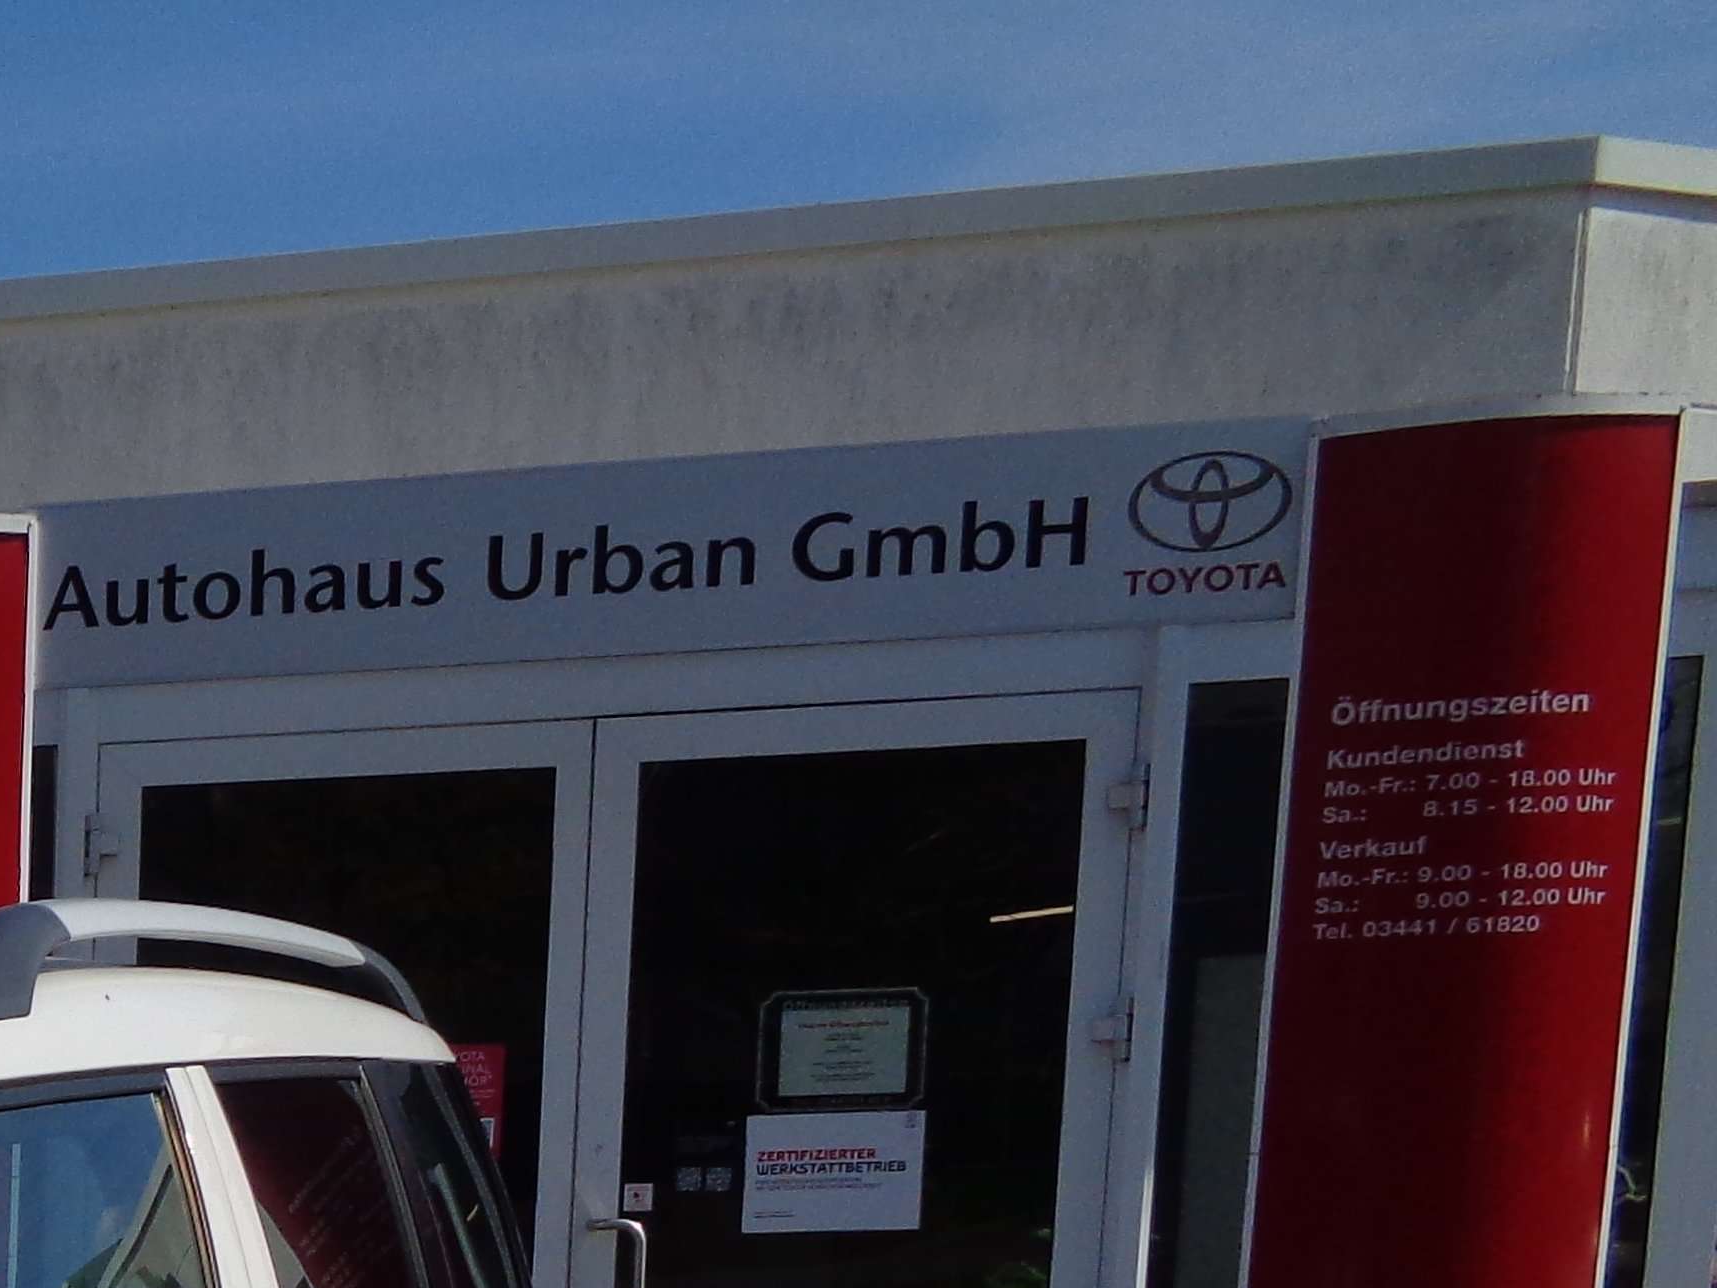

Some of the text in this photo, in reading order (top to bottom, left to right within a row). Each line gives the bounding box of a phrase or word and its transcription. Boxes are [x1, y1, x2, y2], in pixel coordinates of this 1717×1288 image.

[43, 497, 1089, 630] Autohaus Urban GmbH
[1124, 561, 1286, 597] TOYOTA
[1331, 690, 1590, 725] Öffnungszeiten
[1327, 739, 1525, 770] Kundendienst
[1324, 777, 1416, 798] Mo.-Fr.:
[1426, 772, 1480, 791] 7.00
[1508, 769, 1571, 789] 18.00
[1578, 768, 1616, 787] Uhr
[1322, 806, 1366, 823] Sa.:
[1423, 799, 1477, 817] 8.15
[1507, 796, 1569, 814] 12.00
[1576, 794, 1614, 813] Uhr
[1320, 836, 1427, 861] Verkauf
[1417, 865, 1471, 883] 9.00
[1501, 861, 1562, 880] 18.00
[1570, 860, 1608, 879] Uhr
[1314, 896, 1358, 914] Sa.:
[1416, 891, 1469, 909] 9.00
[1498, 889, 1560, 907] 12.00
[1568, 887, 1605, 906] Uhr
[1313, 923, 1352, 940] Tel.
[1363, 920, 1436, 938] 03441
[1465, 915, 1540, 934] 61820
[756, 1160, 906, 1176] WERKSTATTBETRIEB
[757, 1149, 877, 1163] ZERTIFIZIERTER
